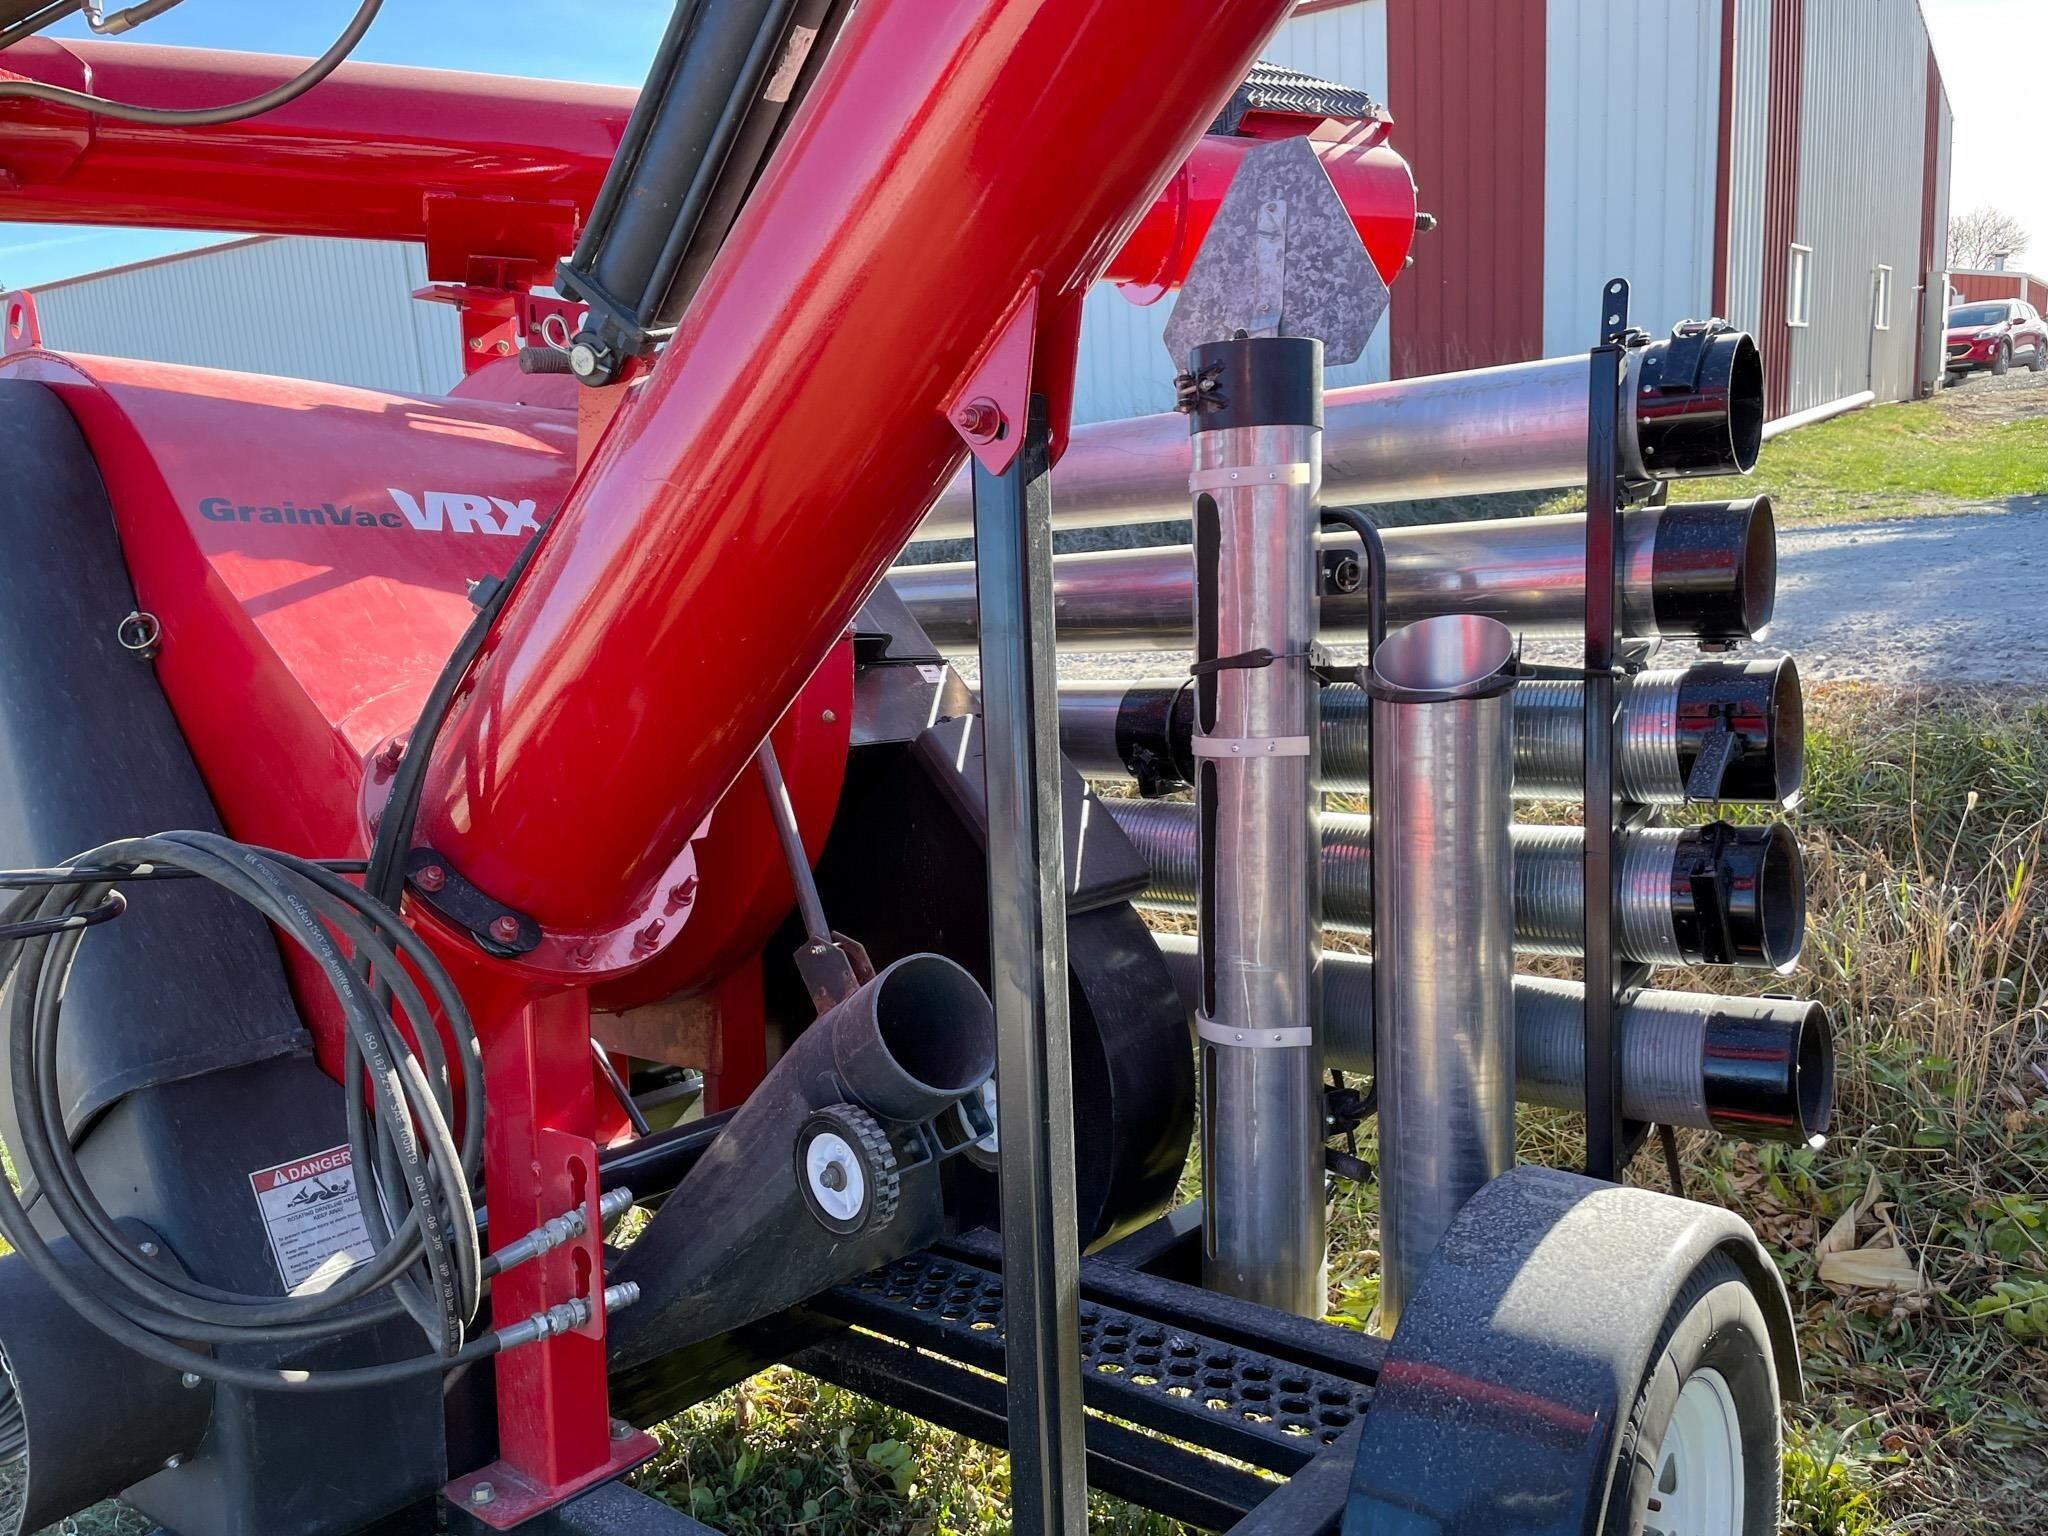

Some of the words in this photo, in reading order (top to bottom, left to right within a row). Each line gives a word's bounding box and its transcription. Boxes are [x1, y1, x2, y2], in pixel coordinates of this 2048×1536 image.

[199, 497, 402, 528] GrainVac
[387, 488, 542, 536] VRX
[329, 958, 353, 999] AntiWear
[364, 1031, 378, 1050] ISO
[391, 1102, 405, 1125] SAE
[288, 1152, 352, 1180] DANGER
[415, 1175, 426, 1192] DN
[343, 1194, 358, 1203] HAZA
[420, 1193, 431, 1207] 10
